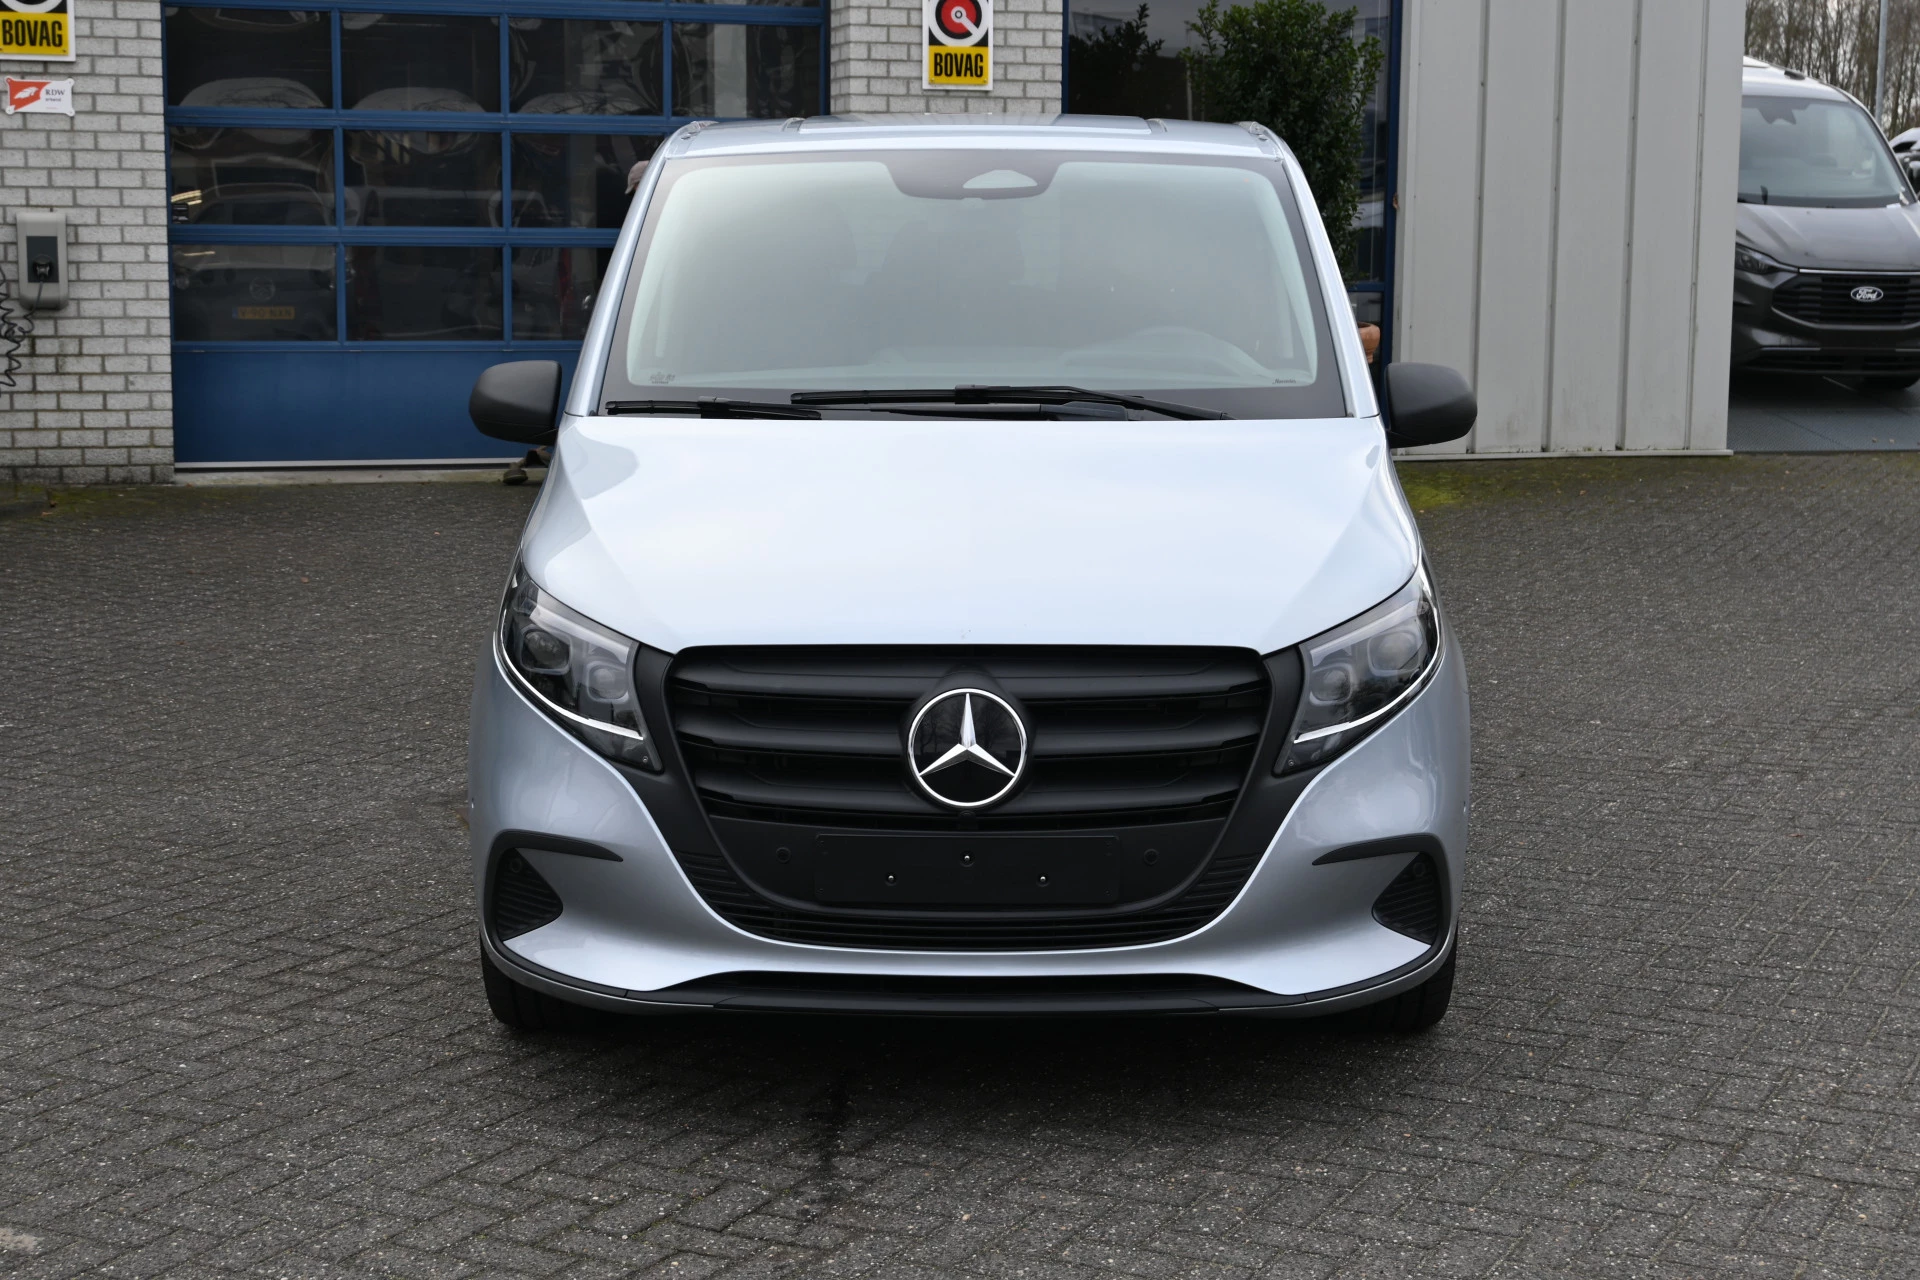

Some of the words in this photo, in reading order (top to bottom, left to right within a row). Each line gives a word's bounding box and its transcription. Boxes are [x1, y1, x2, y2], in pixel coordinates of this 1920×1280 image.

[2, 20, 63, 47] BOVAG
[934, 53, 984, 78] BOVAG
[45, 88, 65, 96] RDW
[1855, 288, 1879, 301] Ford
